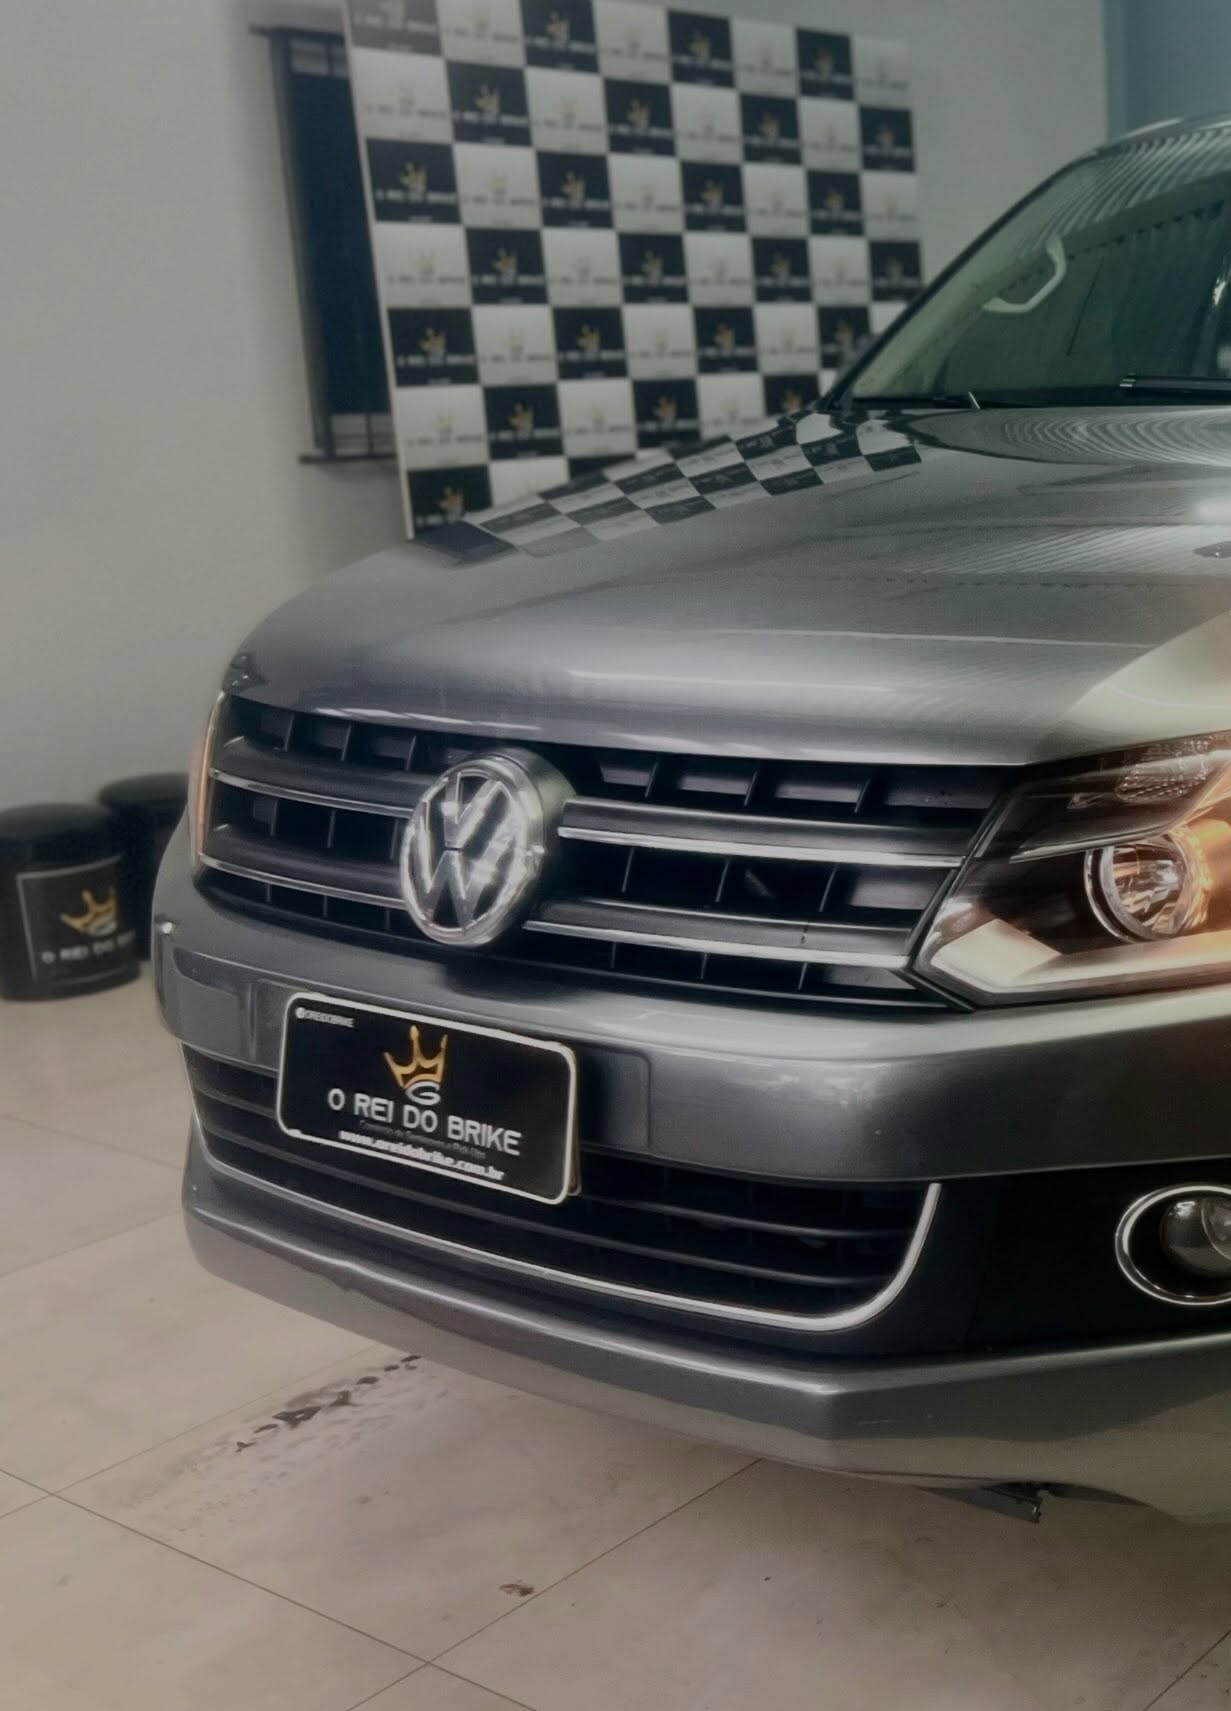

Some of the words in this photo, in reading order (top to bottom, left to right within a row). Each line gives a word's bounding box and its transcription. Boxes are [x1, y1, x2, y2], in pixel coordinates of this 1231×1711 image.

[328, 1088, 346, 1111] O
[354, 1092, 395, 1123] REI
[402, 1104, 438, 1133] DO
[447, 1115, 522, 1157] BRIKE
